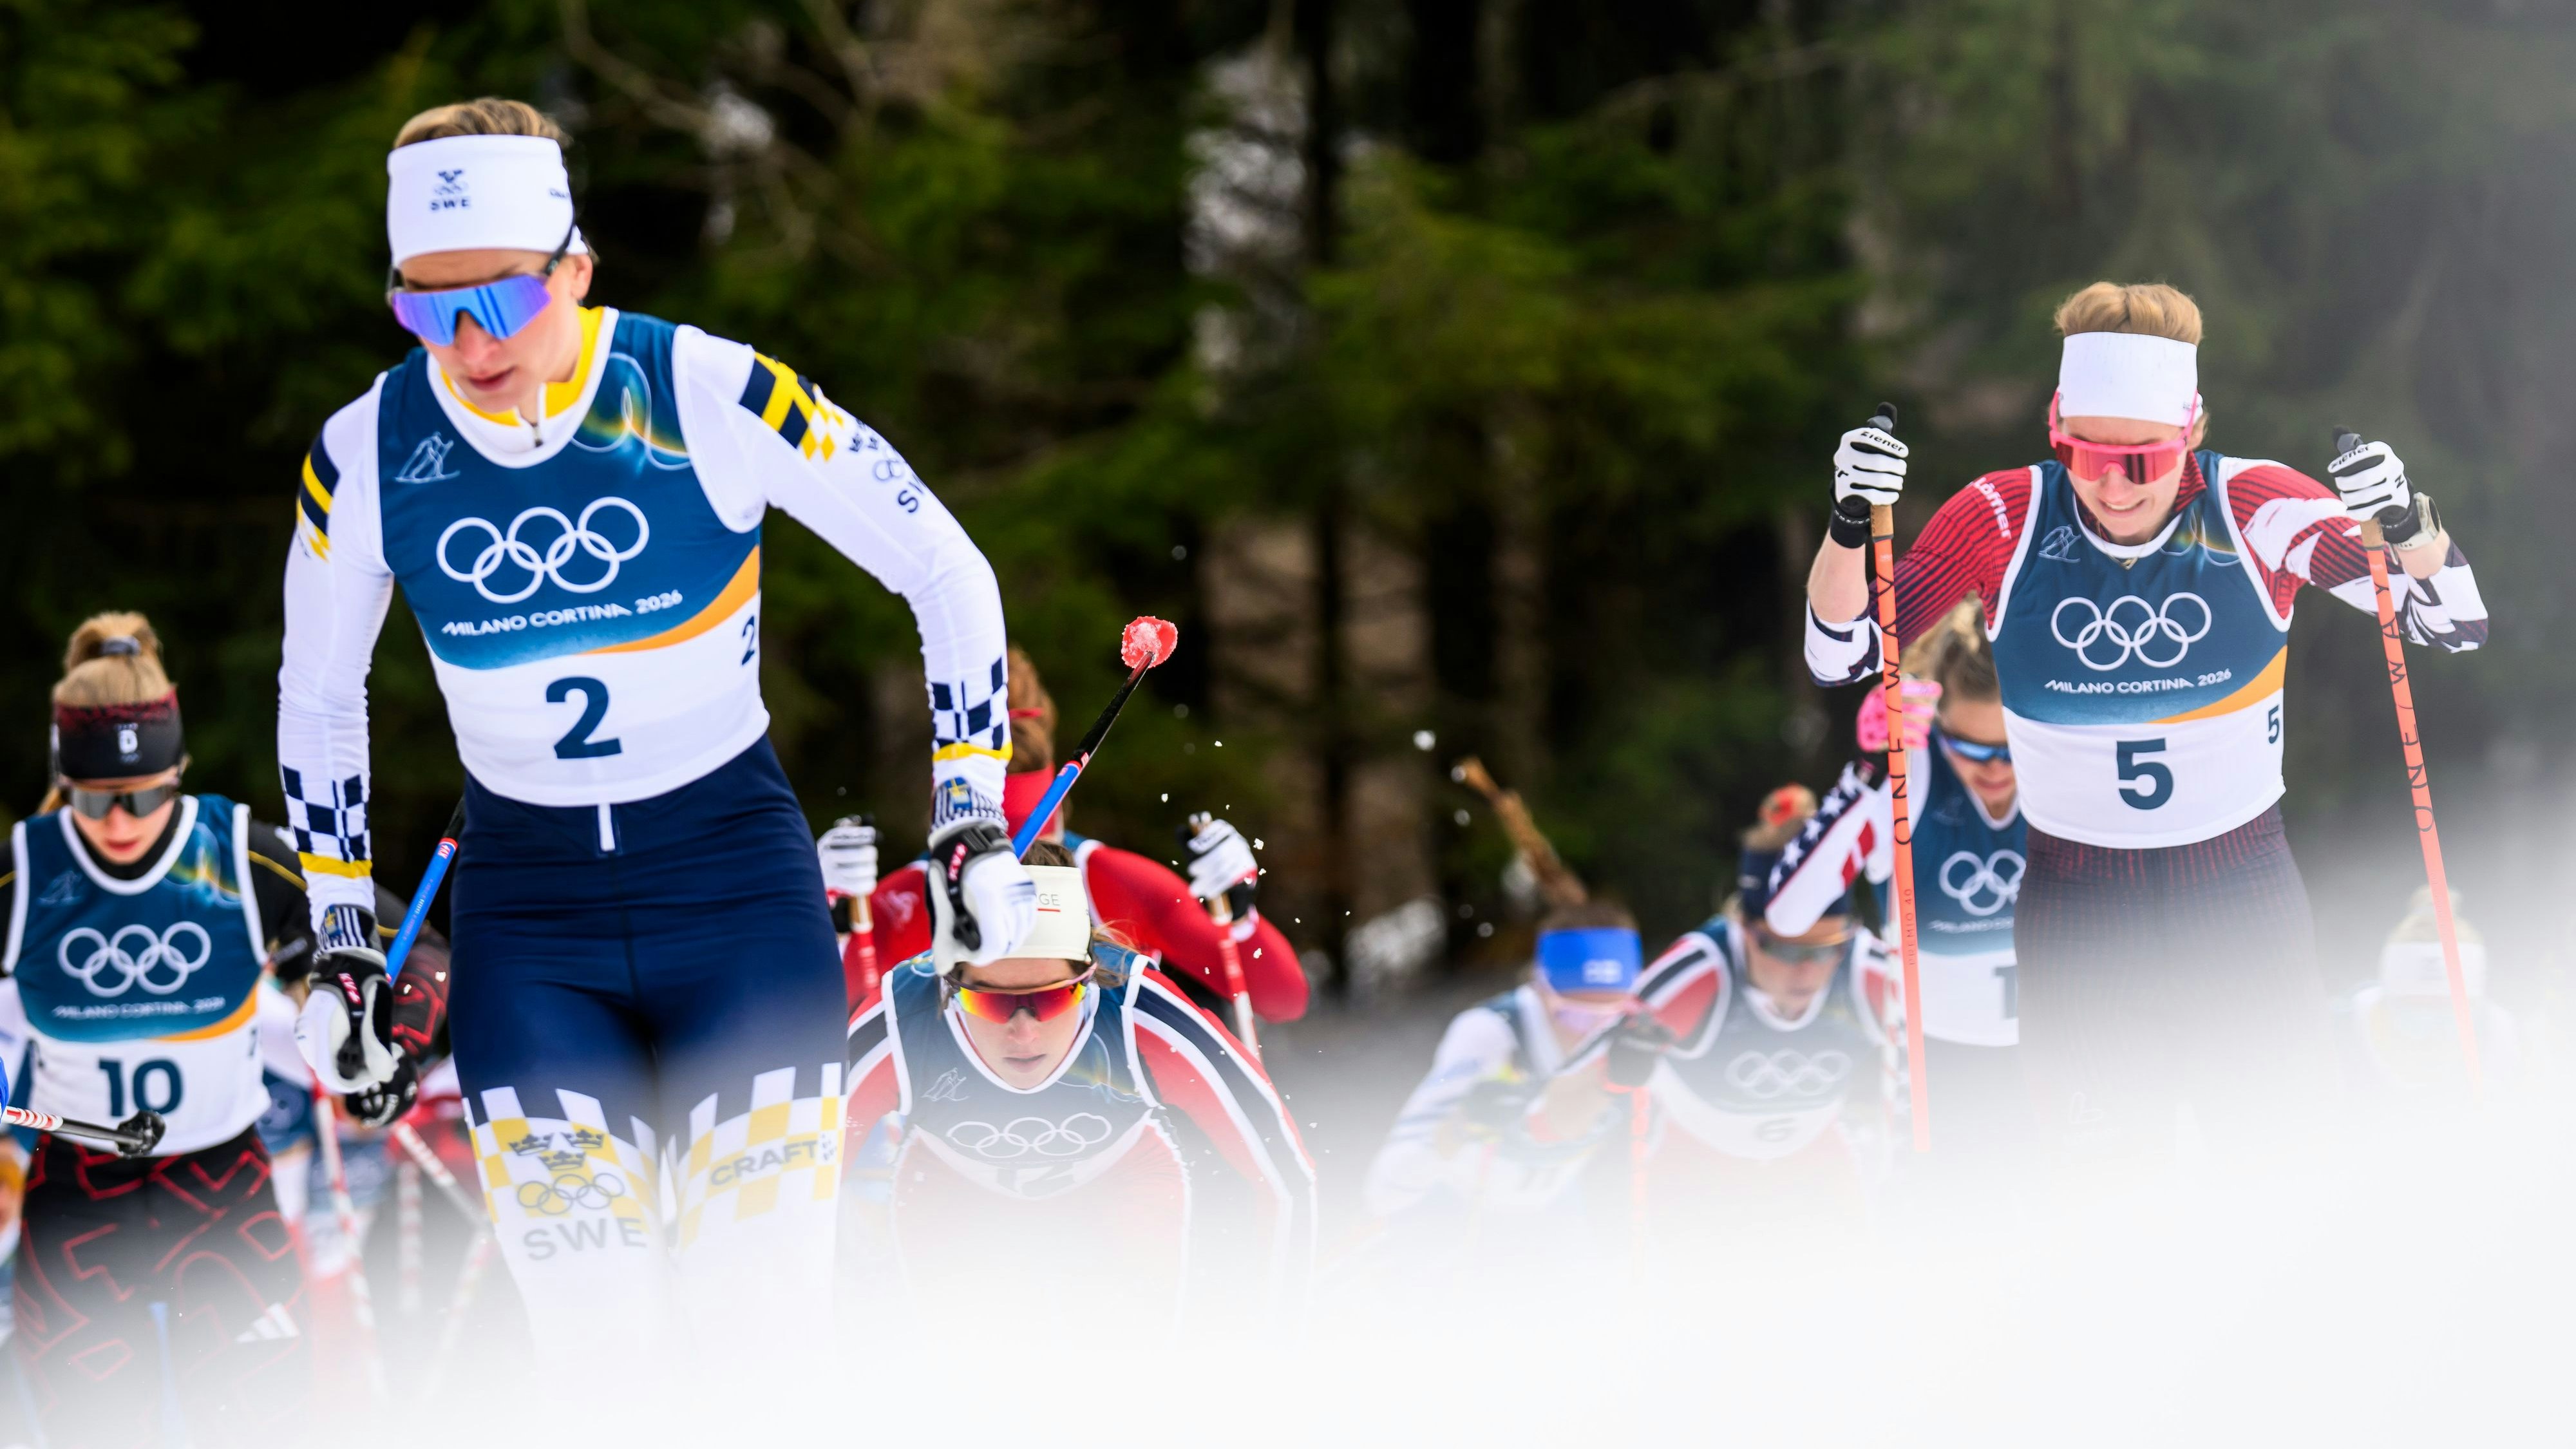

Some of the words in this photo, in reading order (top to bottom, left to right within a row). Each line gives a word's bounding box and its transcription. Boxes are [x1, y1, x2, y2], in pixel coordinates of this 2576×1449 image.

[430, 198, 469, 211] SWE
[441, 614, 527, 636] MILANO
[529, 603, 633, 627] CORTINA
[634, 589, 683, 614] 2026
[741, 616, 755, 666] 2
[2045, 679, 2114, 694] MILANO
[2116, 677, 2195, 694] CORTINA
[2197, 668, 2232, 687] 2026
[545, 676, 623, 759] 2
[2268, 704, 2280, 744] 5
[2116, 737, 2174, 810] 5
[52, 1004, 118, 1020] MILANO
[120, 1000, 192, 1019] CORTINA
[98, 1057, 183, 1118] 10
[710, 1139, 819, 1186] CRAFT
[523, 1217, 647, 1261] SWE
